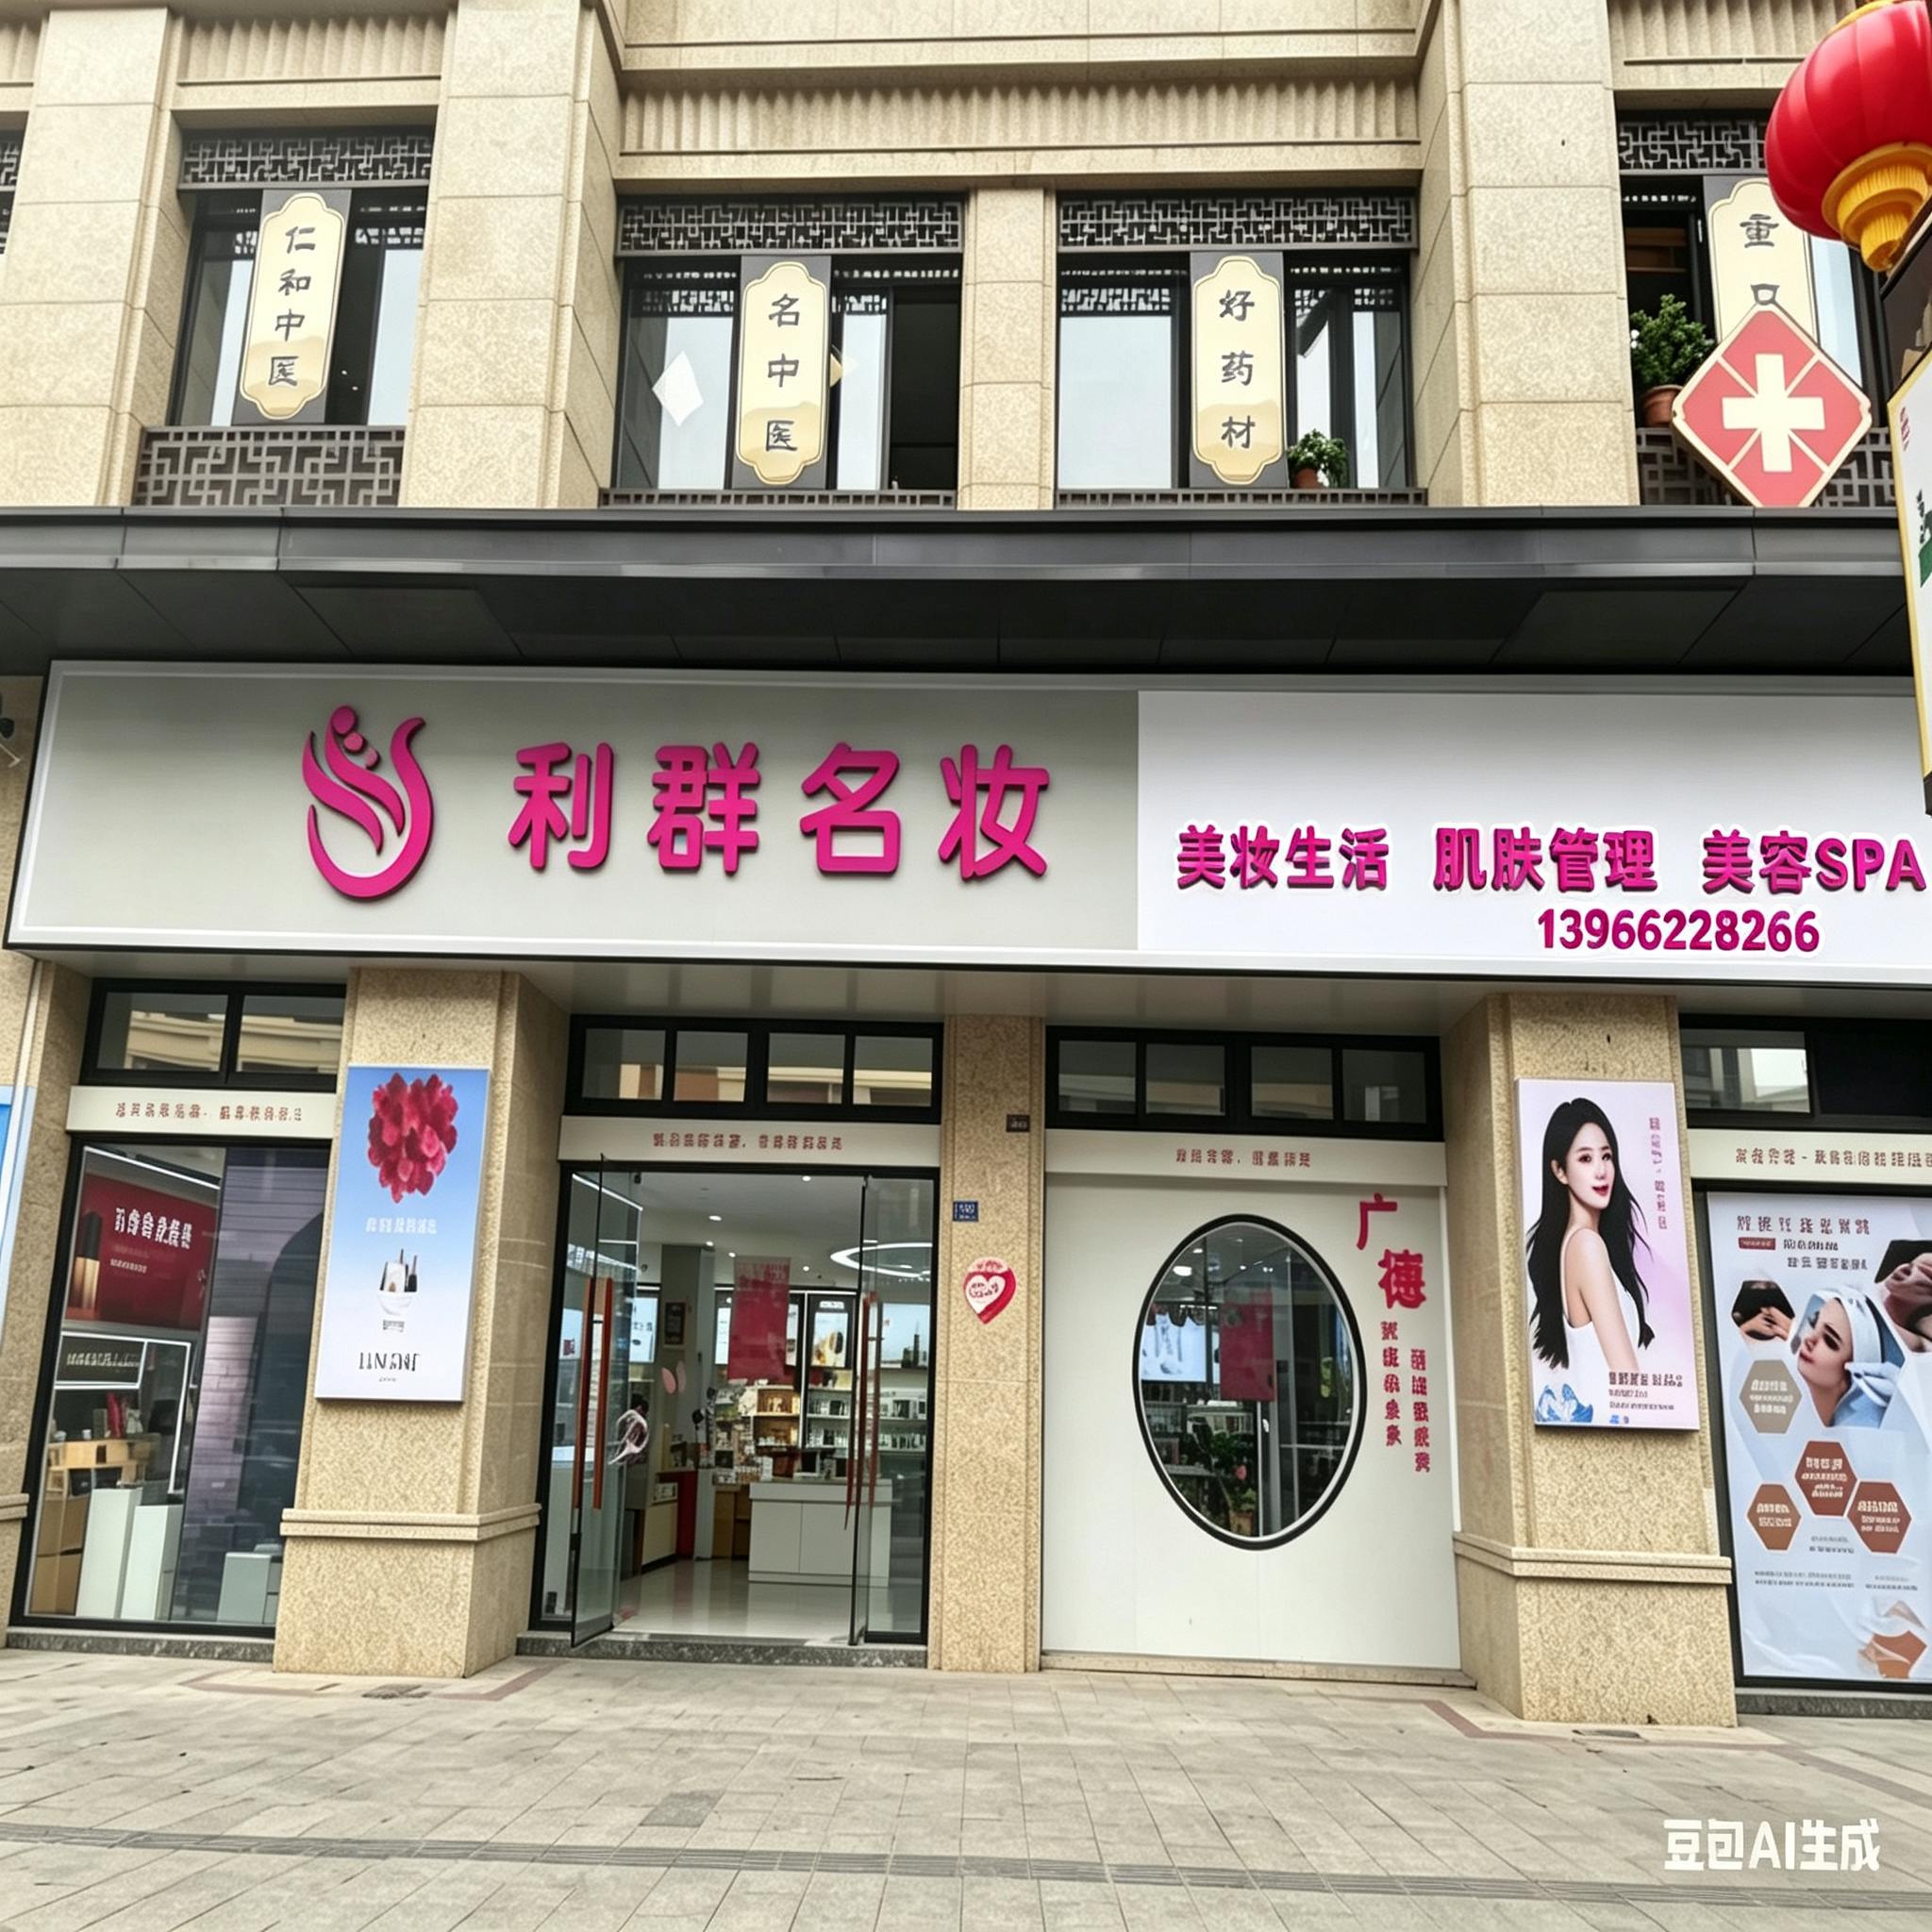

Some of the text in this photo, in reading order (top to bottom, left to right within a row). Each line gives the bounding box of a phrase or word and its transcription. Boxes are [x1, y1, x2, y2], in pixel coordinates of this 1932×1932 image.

[765, 293, 800, 453] 名中医
[1218, 289, 1255, 450] 好药材
[508, 741, 1051, 882] 利群名妆
[1176, 824, 1927, 895] 美妆生活 肌肤管理 美容SPA
[1538, 908, 1821, 952] 13966228266
